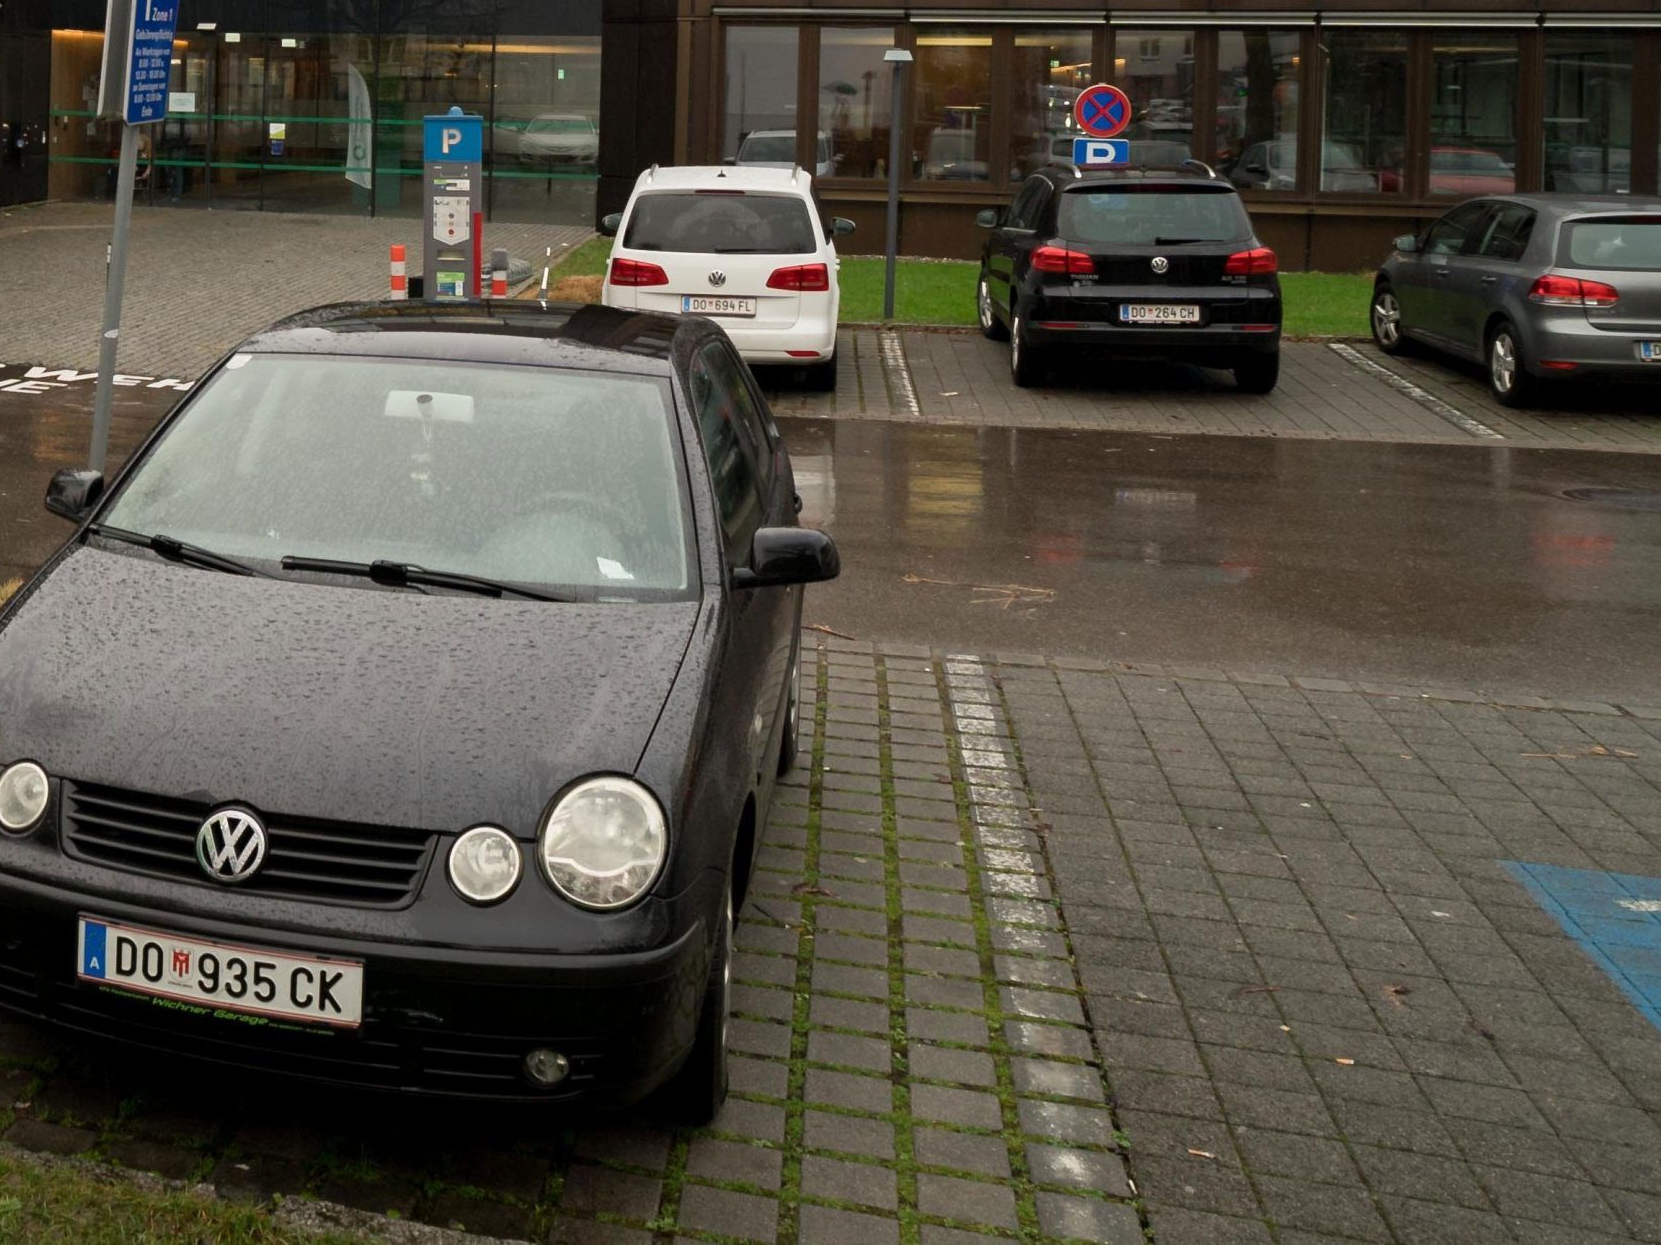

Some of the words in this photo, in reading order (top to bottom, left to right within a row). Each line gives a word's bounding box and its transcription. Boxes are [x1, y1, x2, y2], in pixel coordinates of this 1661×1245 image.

[152, 7, 168, 22] Zone
[442, 128, 462, 154] P
[693, 299, 707, 310] DO
[715, 299, 735, 311] 694
[738, 300, 752, 312] FL
[1131, 306, 1147, 318] DO
[1155, 307, 1177, 318] 264
[1179, 307, 1195, 319] CH
[24, 365, 197, 392] WEH
[89, 956, 100, 970] A
[116, 935, 164, 983] DO
[197, 952, 277, 1004] 935
[289, 966, 343, 1014] CK
